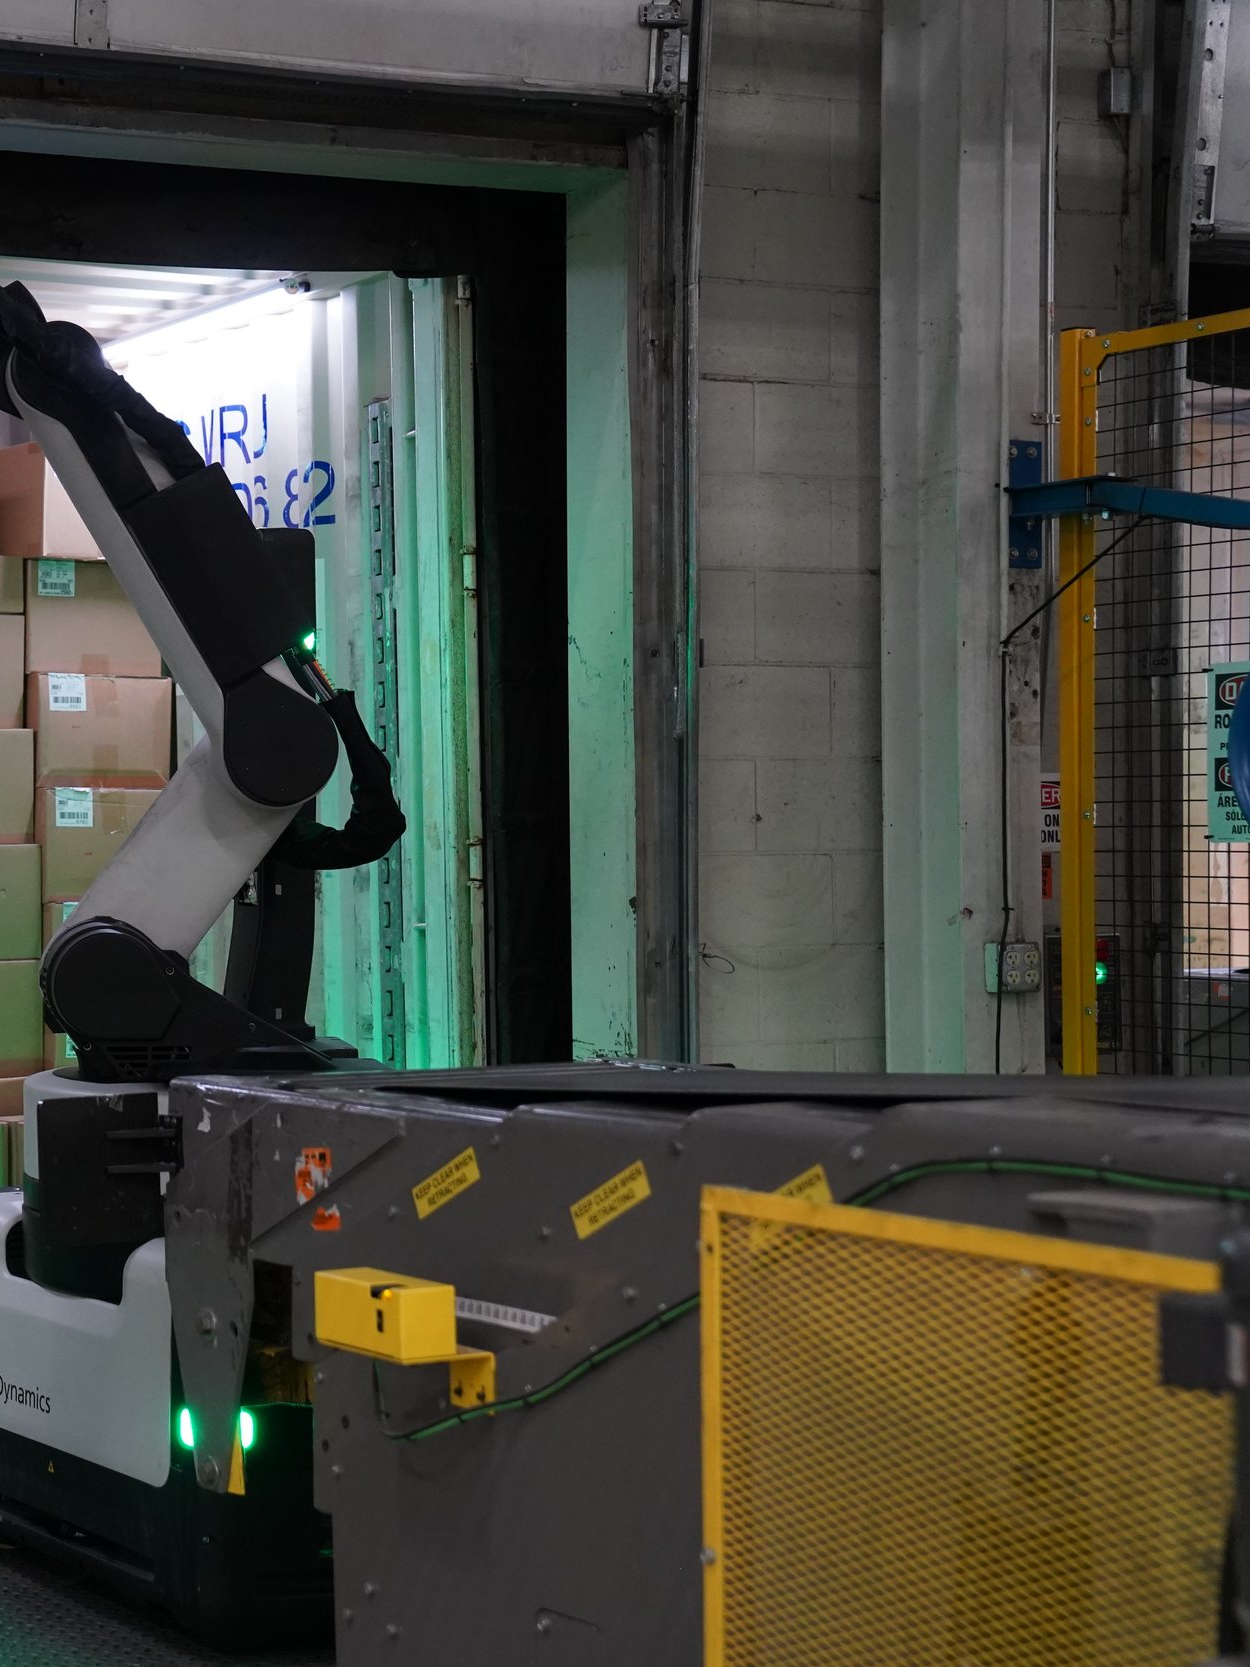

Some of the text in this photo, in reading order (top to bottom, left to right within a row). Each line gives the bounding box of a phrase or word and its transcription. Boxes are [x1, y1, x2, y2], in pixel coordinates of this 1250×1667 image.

[1217, 796, 1238, 808] ÁRE
[1041, 830, 1061, 843] ONL
[415, 1155, 473, 1200] KEEP CLEAR WHEN
[427, 1172, 468, 1207] RETRACTING
[574, 1167, 642, 1218] KEEP CLEAR WHEN
[588, 1187, 635, 1225] RETRACTING
